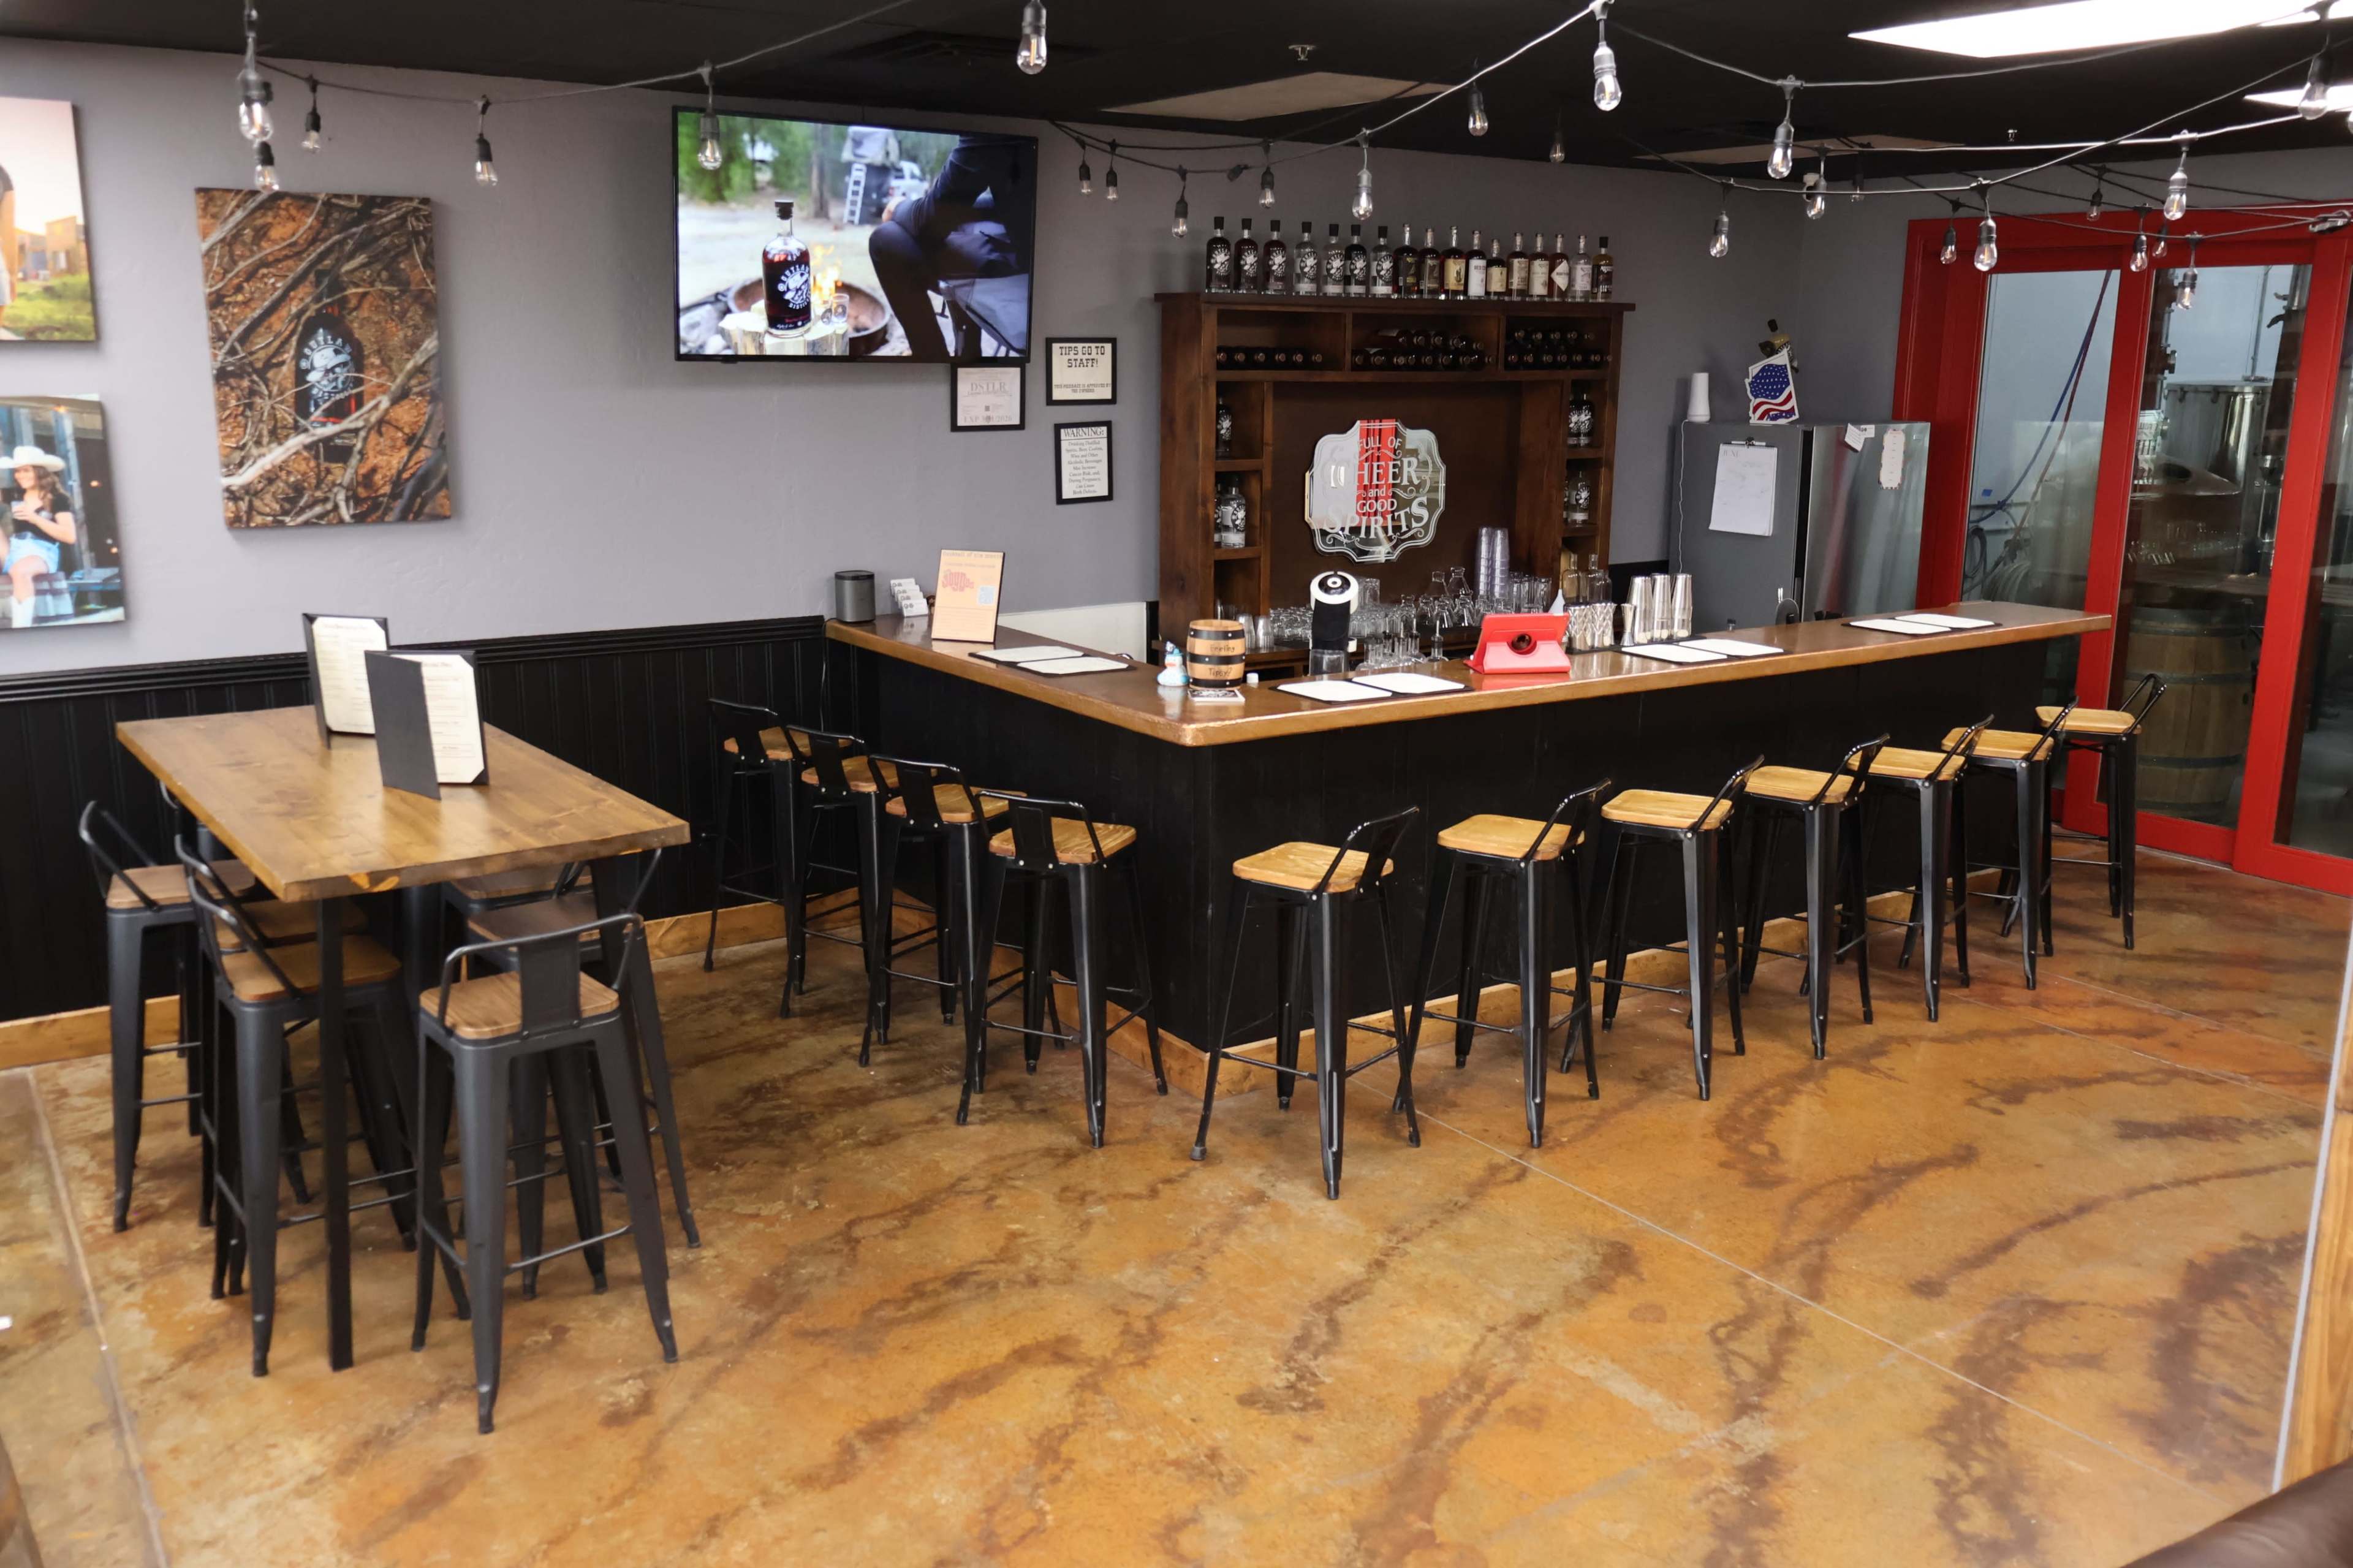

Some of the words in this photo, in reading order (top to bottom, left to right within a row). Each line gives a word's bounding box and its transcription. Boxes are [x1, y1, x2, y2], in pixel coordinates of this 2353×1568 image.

[1059, 346, 1078, 355] TIPS
[1082, 346, 1092, 355] GO
[1094, 346, 1105, 355] TO
[1067, 358, 1098, 368] STAFF!
[1063, 426, 1104, 437] WARNING:
[1358, 436, 1382, 452] FULL
[1387, 436, 1403, 449] OF
[1368, 485, 1387, 497] and
[1357, 498, 1398, 513] GOOD
[1323, 496, 1430, 539] SPIRITS
